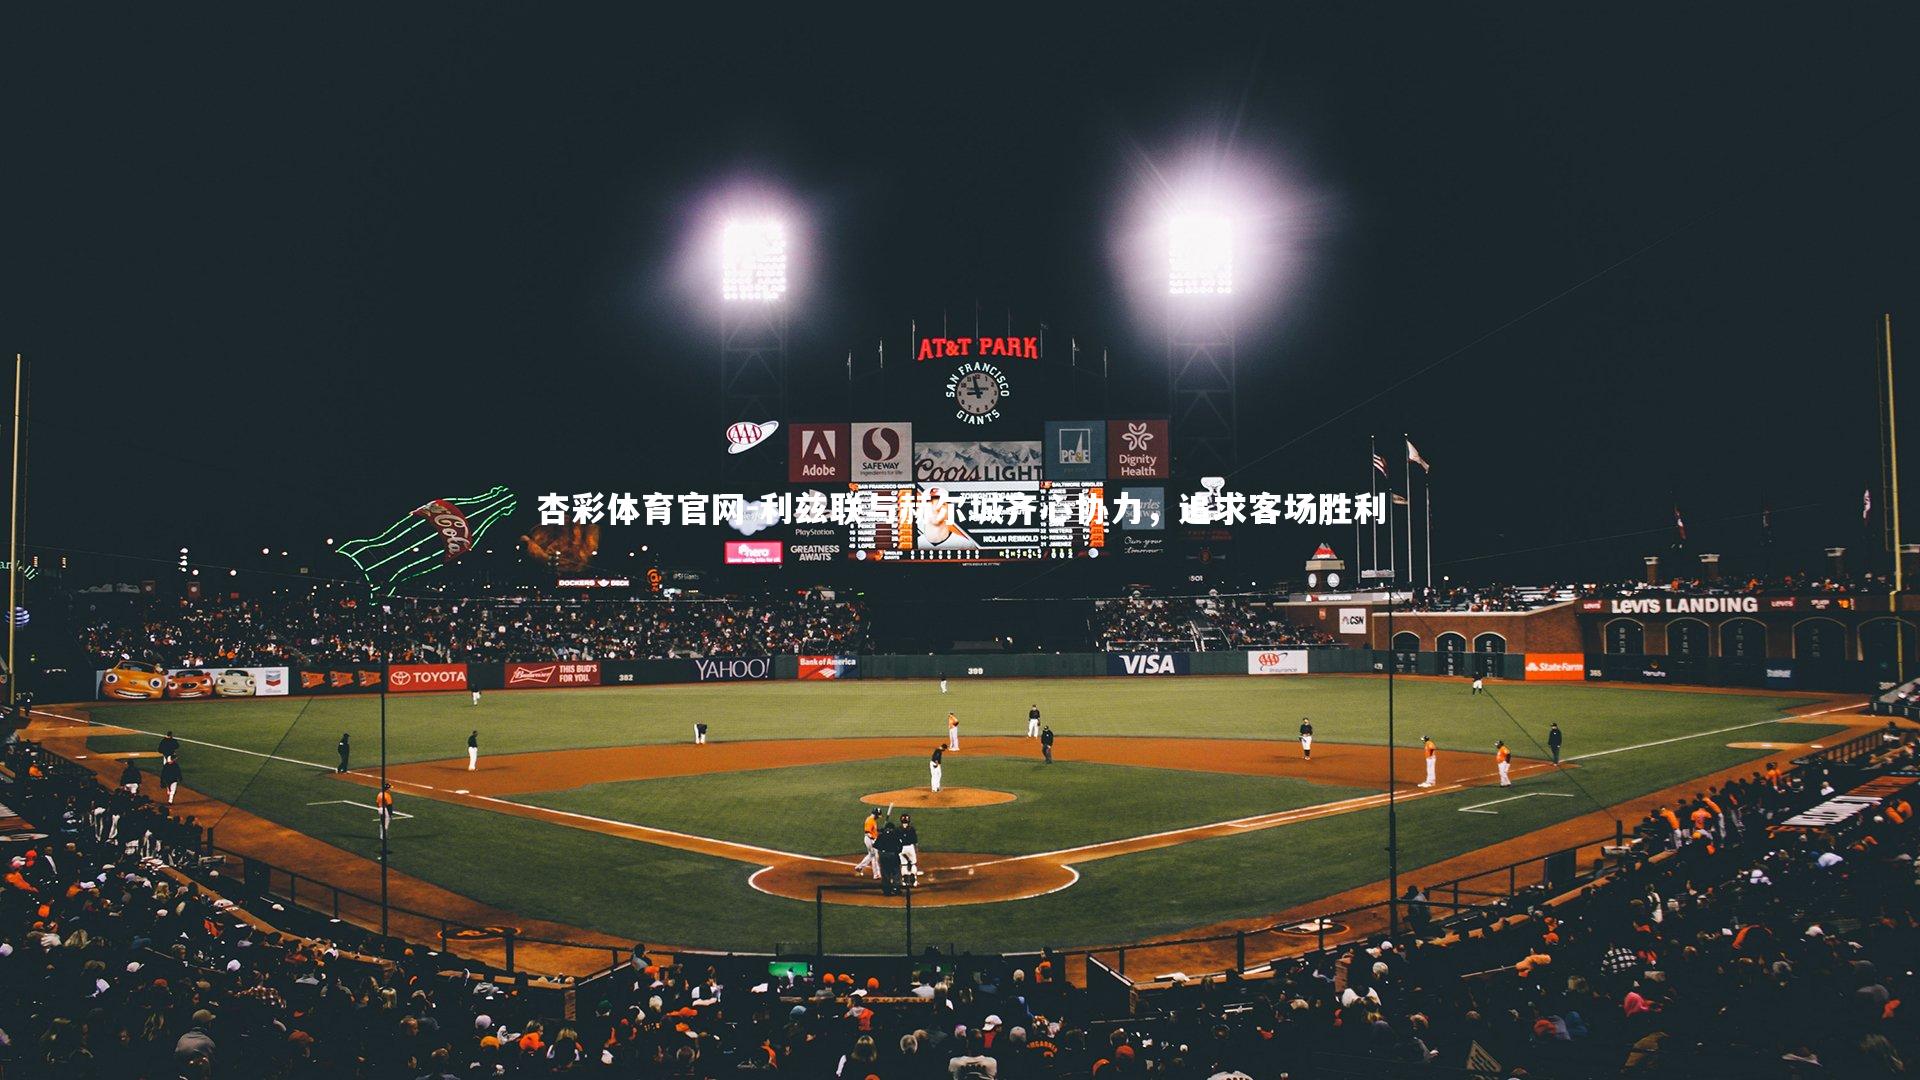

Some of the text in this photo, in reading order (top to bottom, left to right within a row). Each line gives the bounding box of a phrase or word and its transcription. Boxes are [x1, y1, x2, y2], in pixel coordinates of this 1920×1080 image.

[918, 336, 1039, 361] AT&T PARK
[946, 361, 1010, 398] SAN FRANCISCO
[956, 409, 1001, 425] GIANTS
[729, 423, 762, 444] AAA
[1061, 449, 1089, 463] PG&E
[1119, 454, 1157, 467] Dignity
[802, 464, 836, 476] Adobe
[862, 462, 900, 471] SAFEWAY
[914, 458, 1043, 482] Coors LIGHT
[1121, 466, 1156, 477] Health
[795, 528, 835, 537] PlayStation
[790, 545, 840, 554] GREATNESS
[799, 553, 832, 562] AWAITS
[559, 579, 596, 587] DOCKERS
[1665, 597, 1758, 613] LANDING
[1349, 616, 1364, 625] CSN
[800, 658, 857, 666] Bank of America
[1119, 654, 1176, 674] VISA
[559, 665, 598, 673] THIS BUD'S
[695, 658, 771, 681] YAHOO!
[413, 671, 467, 683] TOYOTA
[559, 674, 590, 683] FOR YOU.
